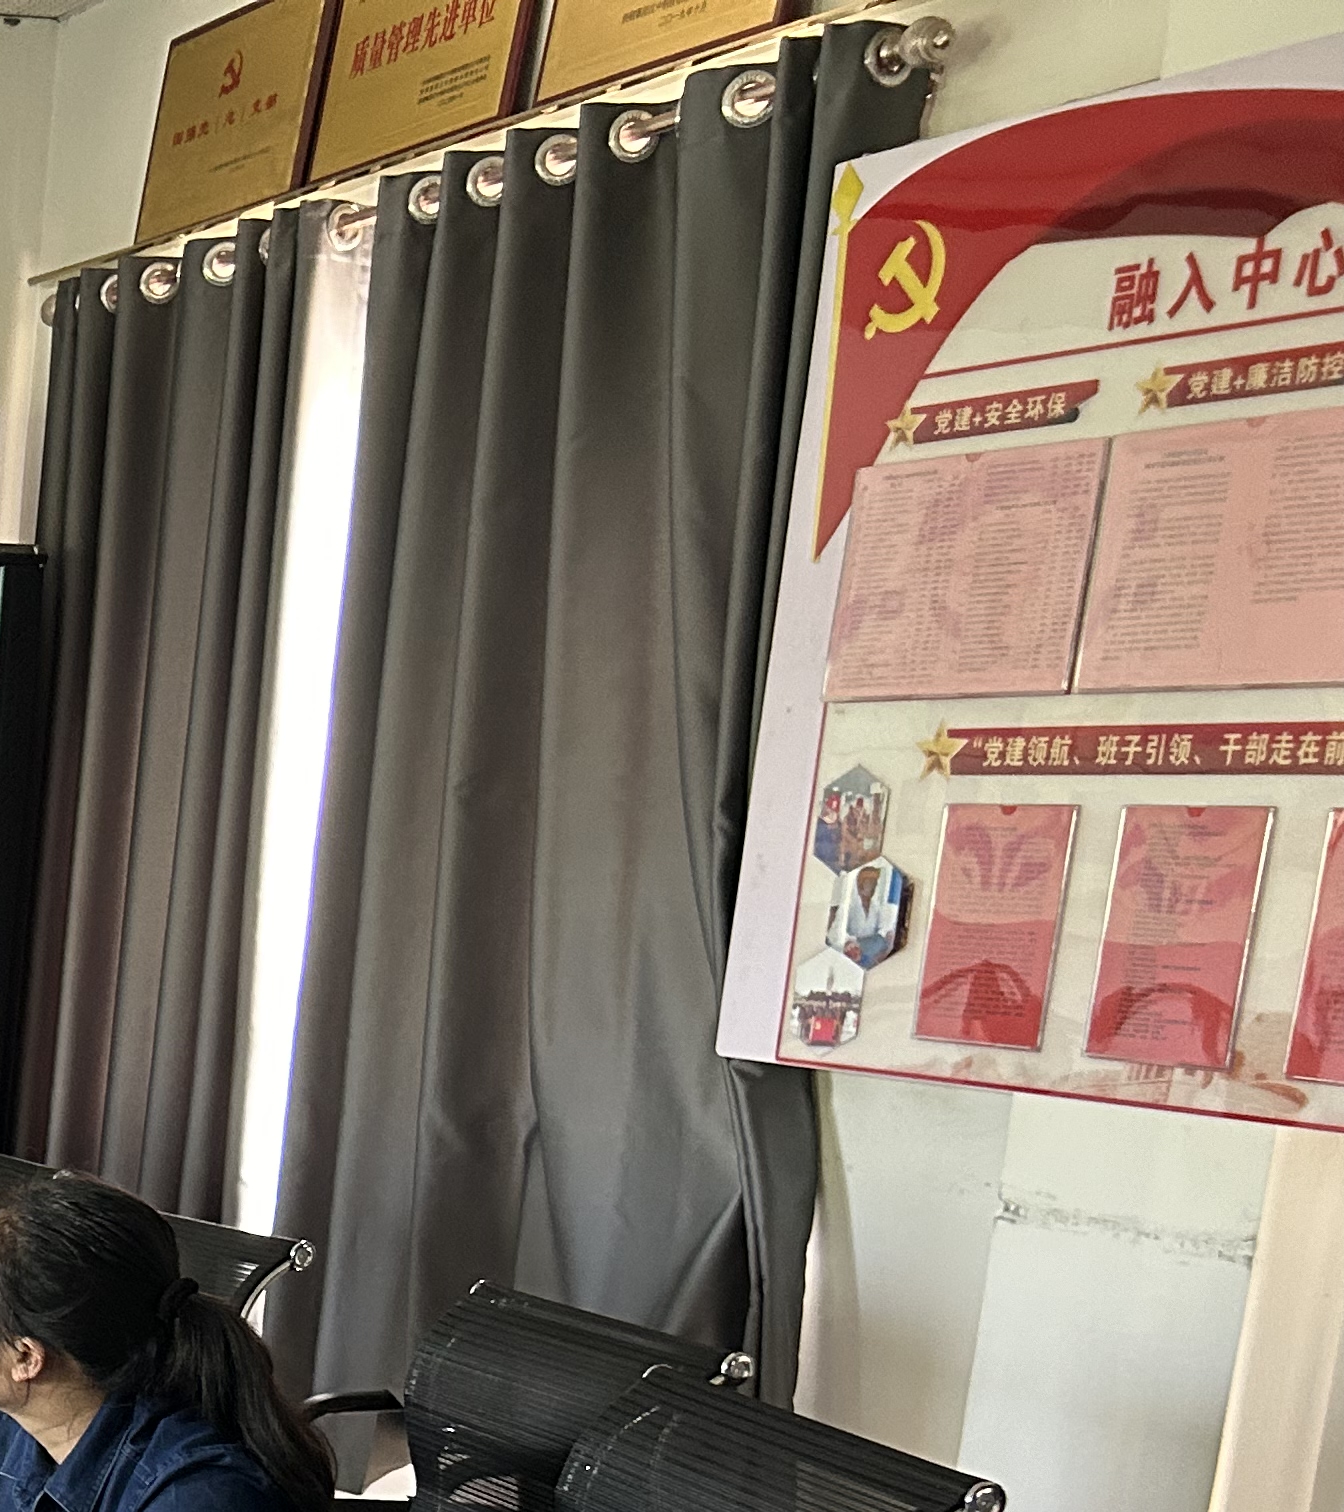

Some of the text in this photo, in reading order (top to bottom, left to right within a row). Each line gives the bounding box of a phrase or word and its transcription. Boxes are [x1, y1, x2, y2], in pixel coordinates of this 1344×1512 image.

[349, 0, 495, 79] 质量管理先进单位
[1107, 228, 1344, 331] 融入中心
[1184, 349, 1344, 402] 党建+廉洁防控
[932, 391, 1068, 437] 党建+安全环保
[971, 731, 1344, 768] “党建领航、班子引领、干部走在前
